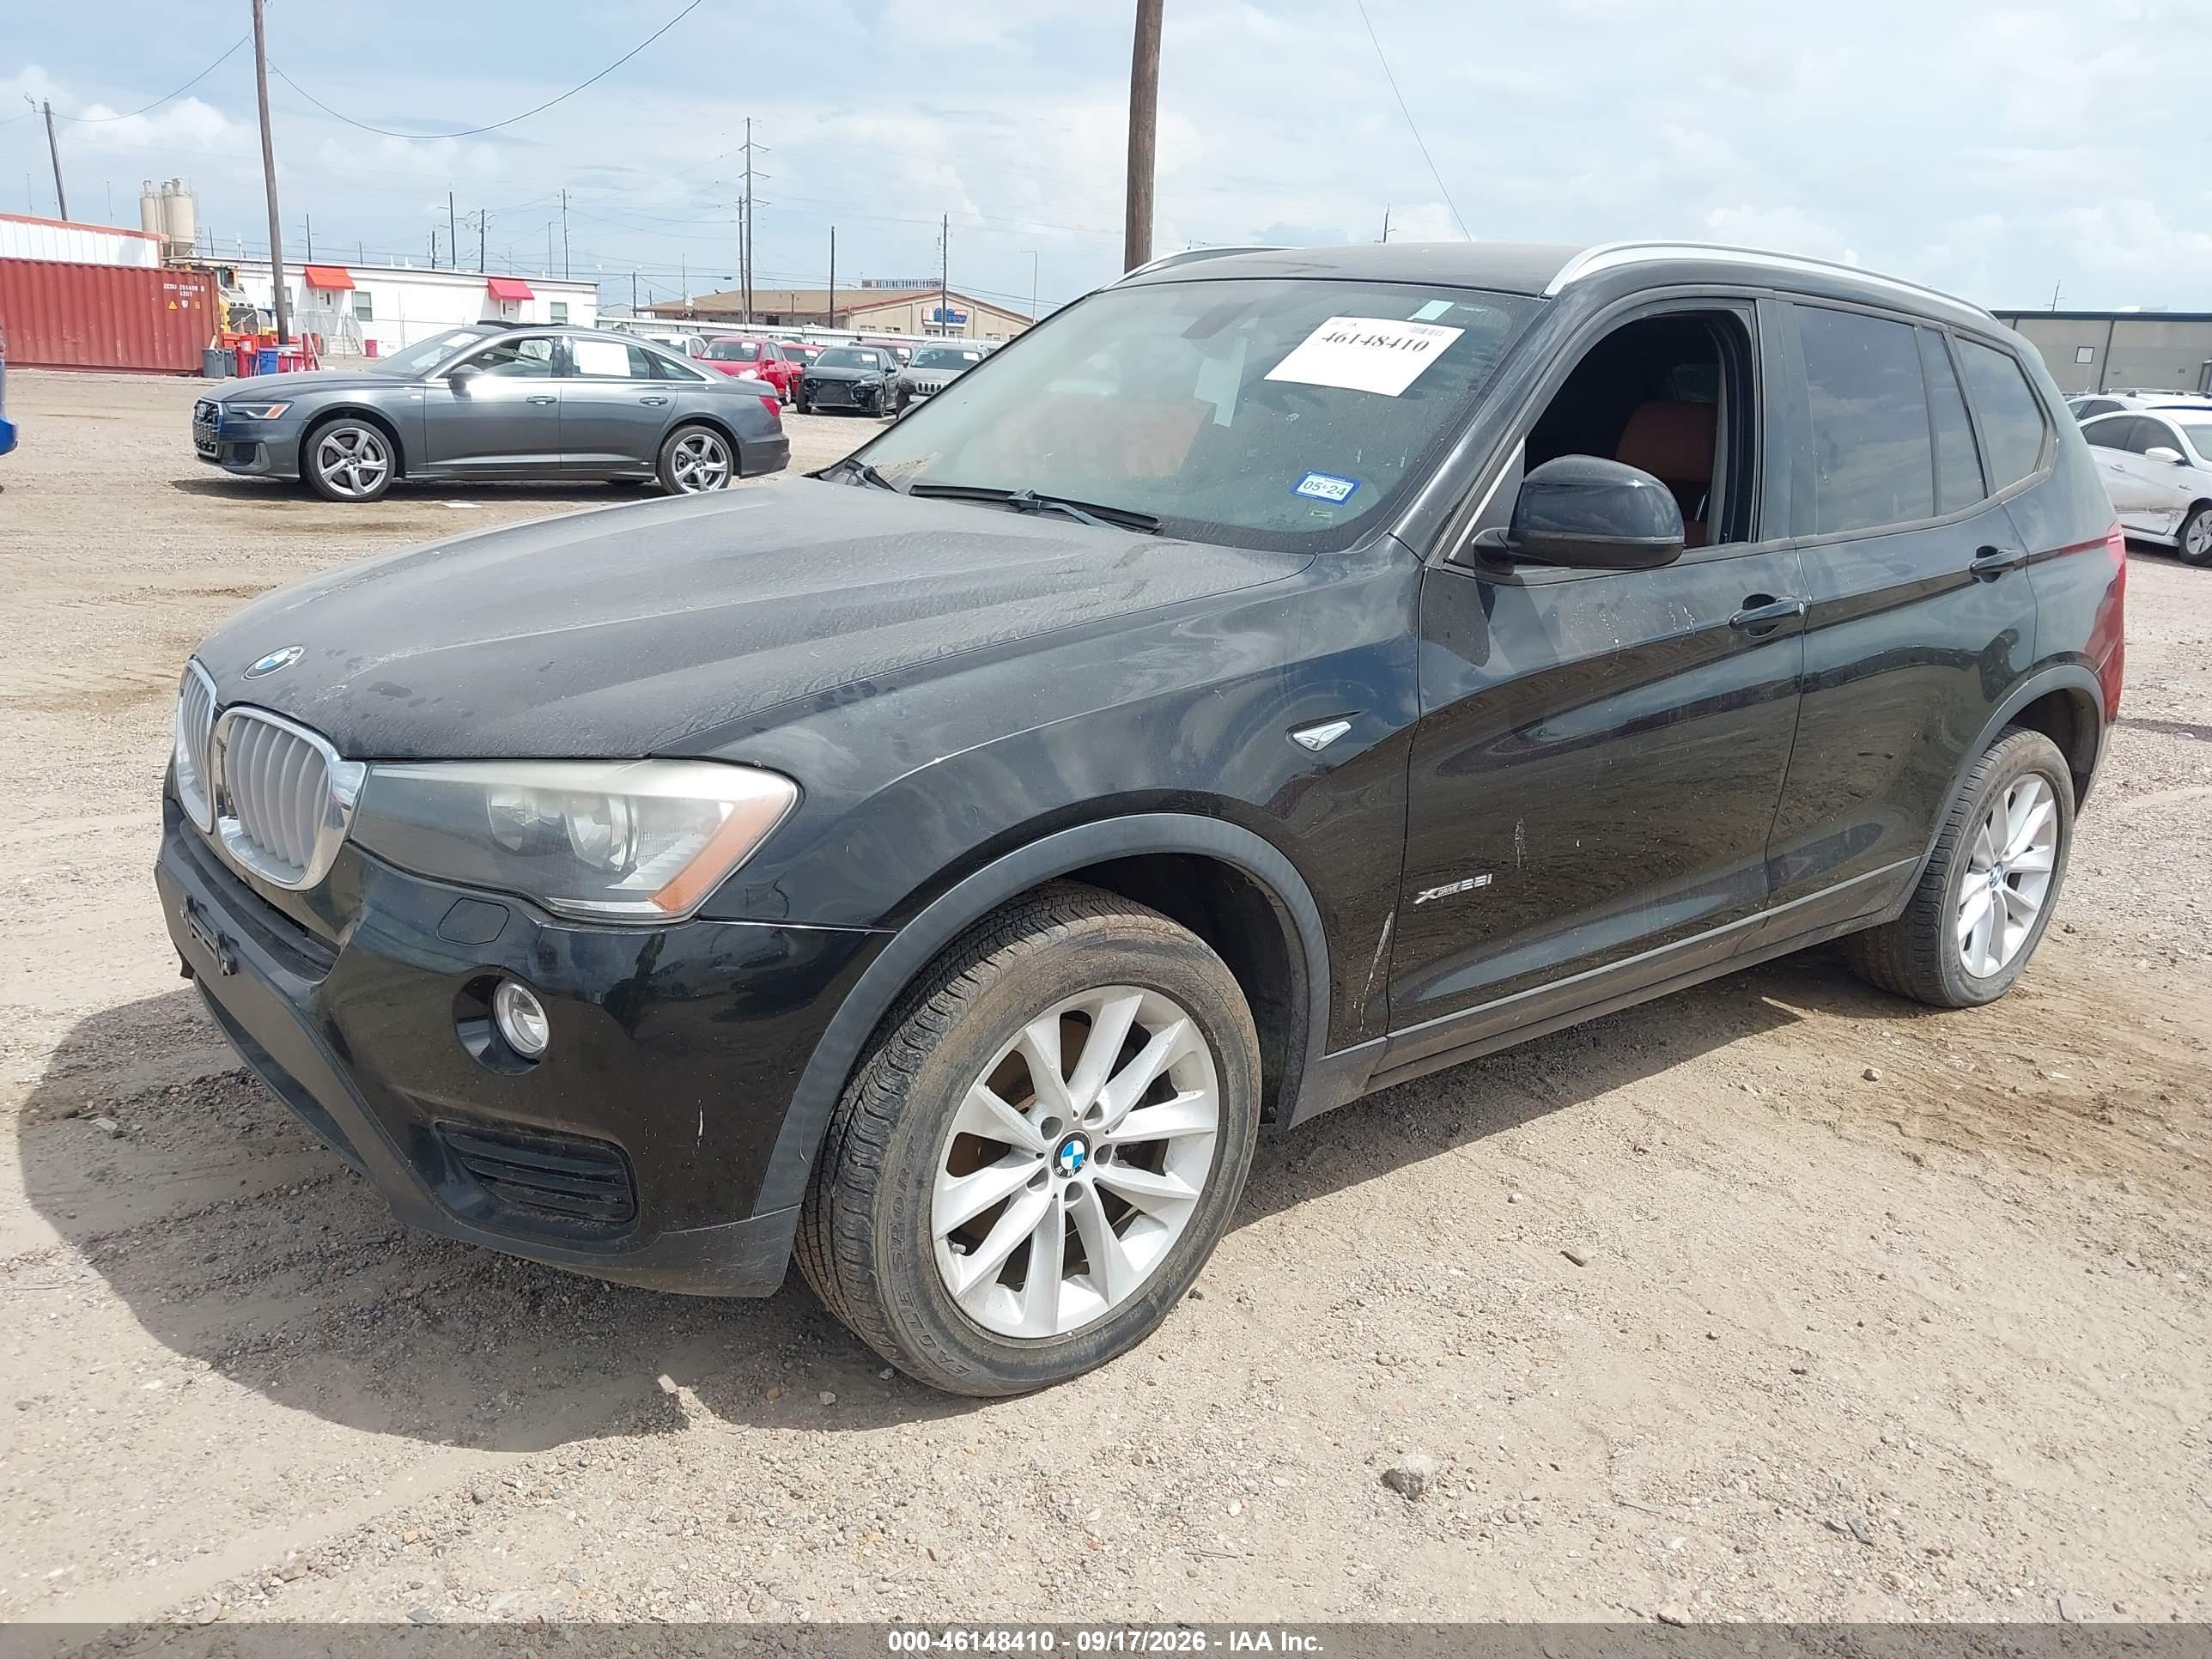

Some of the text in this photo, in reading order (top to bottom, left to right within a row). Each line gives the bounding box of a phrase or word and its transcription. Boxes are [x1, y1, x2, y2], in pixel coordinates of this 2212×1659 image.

[1321, 331, 1431, 353] 46148410
[1303, 480, 1324, 491] 05
[1325, 484, 1347, 497] 24
